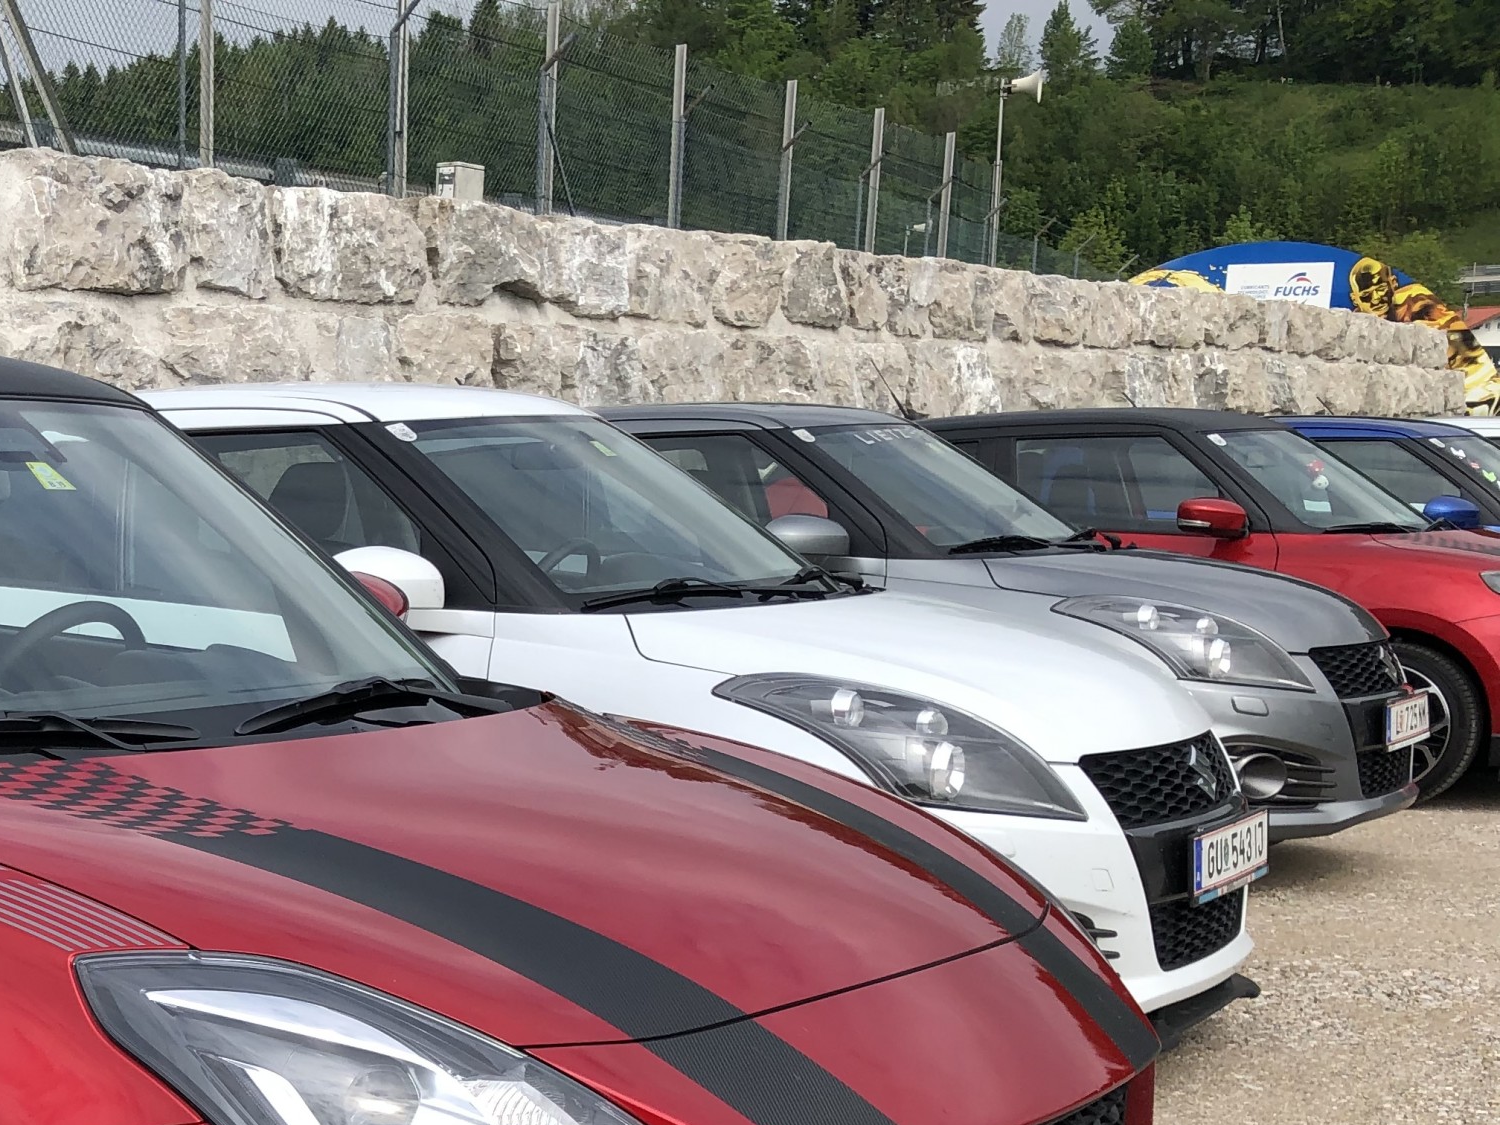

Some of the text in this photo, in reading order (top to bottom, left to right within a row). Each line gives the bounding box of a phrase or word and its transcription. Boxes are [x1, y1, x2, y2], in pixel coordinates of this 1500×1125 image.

[1274, 285, 1320, 297] FUCHS
[1207, 837, 1223, 879] GU
[1231, 827, 1252, 869] 543
